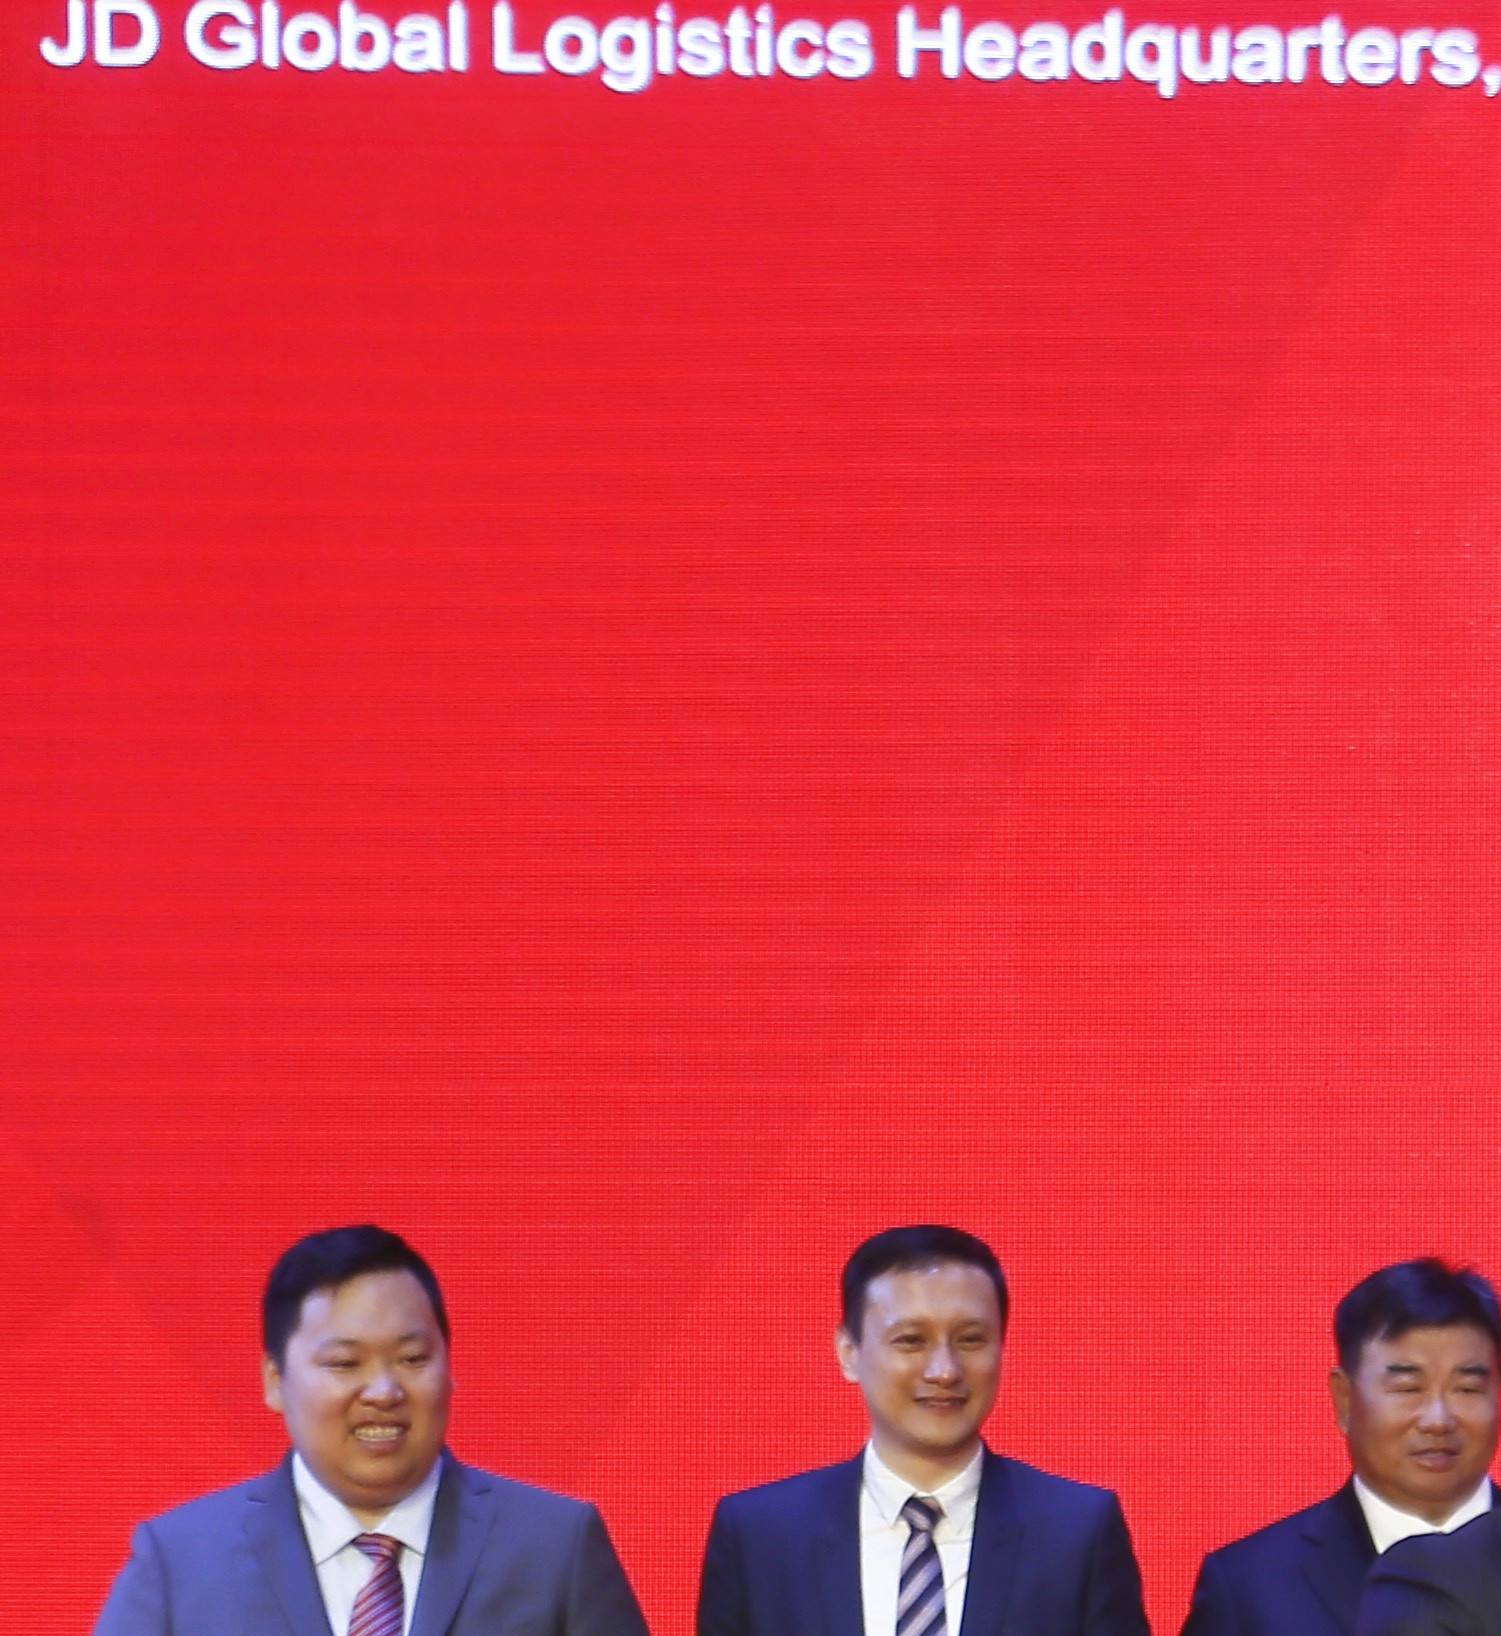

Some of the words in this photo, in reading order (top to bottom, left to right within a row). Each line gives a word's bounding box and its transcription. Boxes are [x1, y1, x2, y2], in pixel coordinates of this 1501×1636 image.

[39, 0, 160, 67] JD
[185, 0, 469, 72] Global
[493, 1, 873, 92] Logistics
